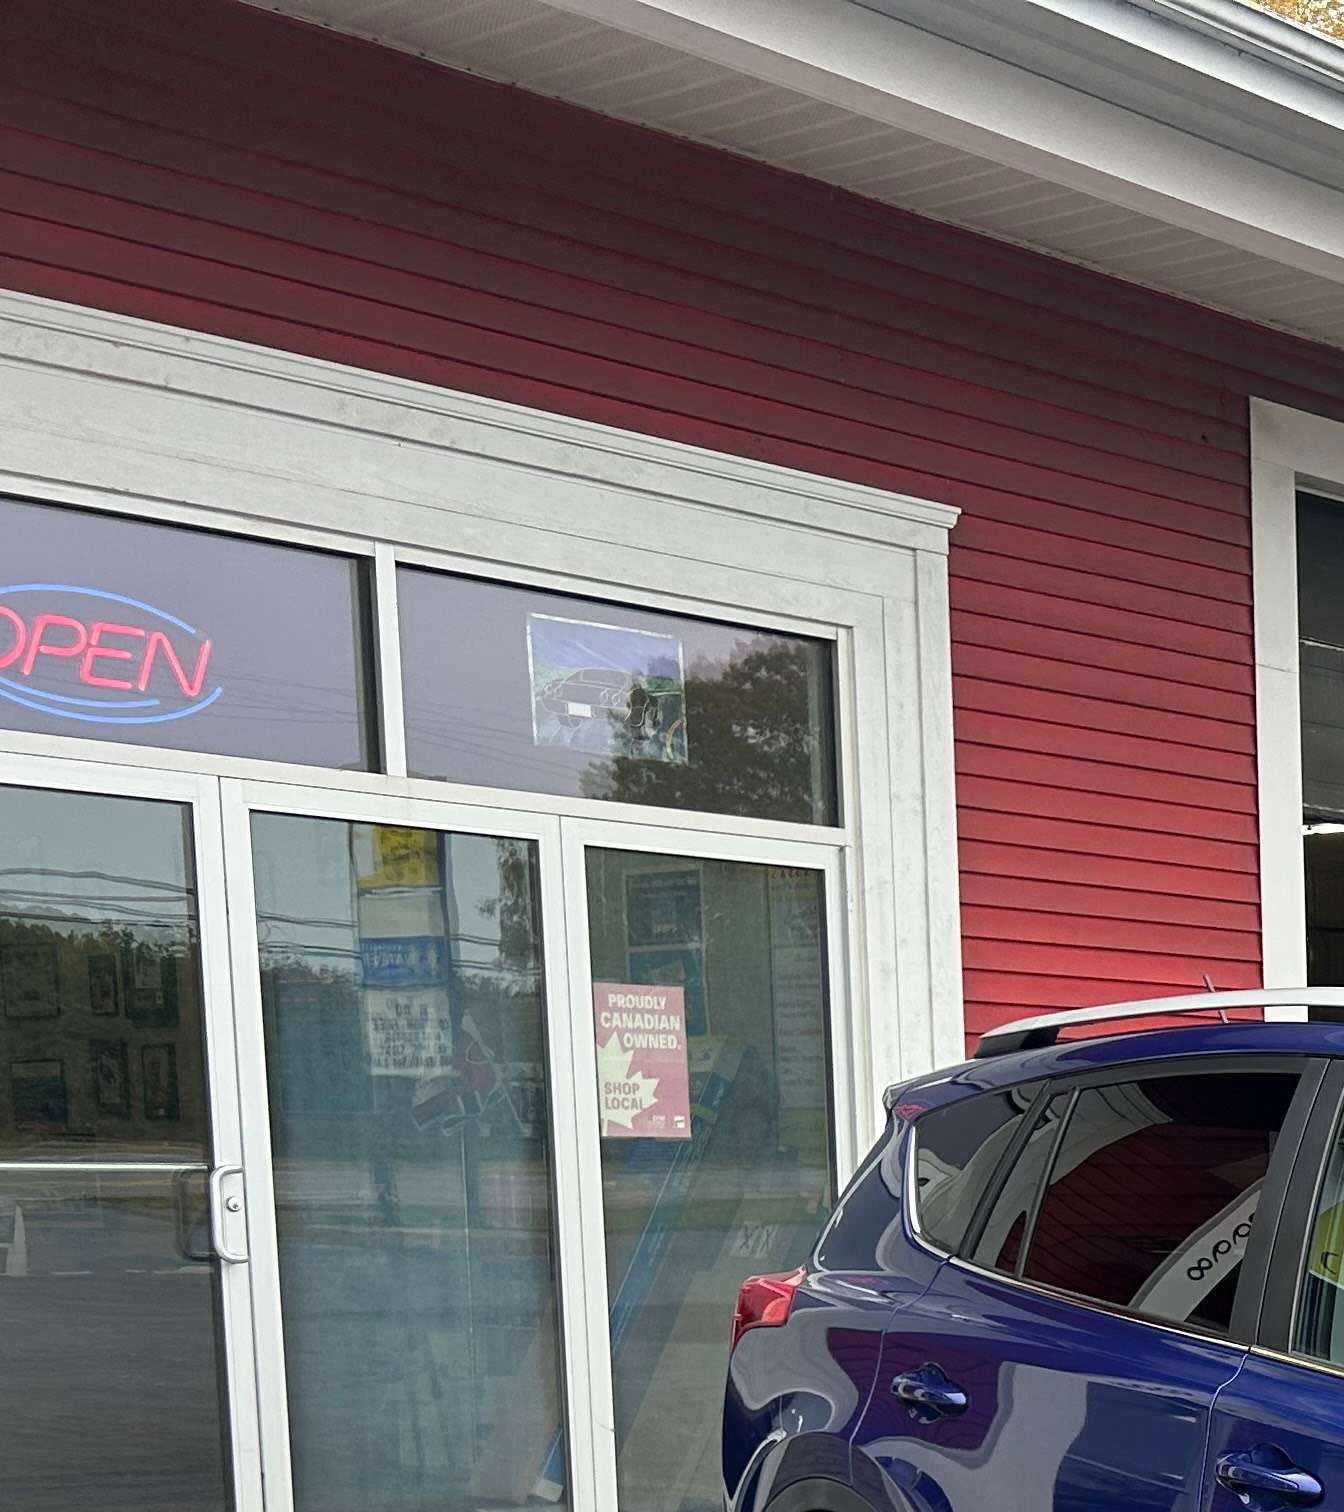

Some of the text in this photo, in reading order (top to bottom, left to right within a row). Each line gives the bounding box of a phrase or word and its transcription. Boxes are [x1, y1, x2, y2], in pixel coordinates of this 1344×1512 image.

[607, 993, 666, 1010] PROUDLY
[600, 1012, 681, 1030] CANADIAN
[623, 1032, 682, 1049] OWNED.
[604, 1081, 641, 1096] SHOP
